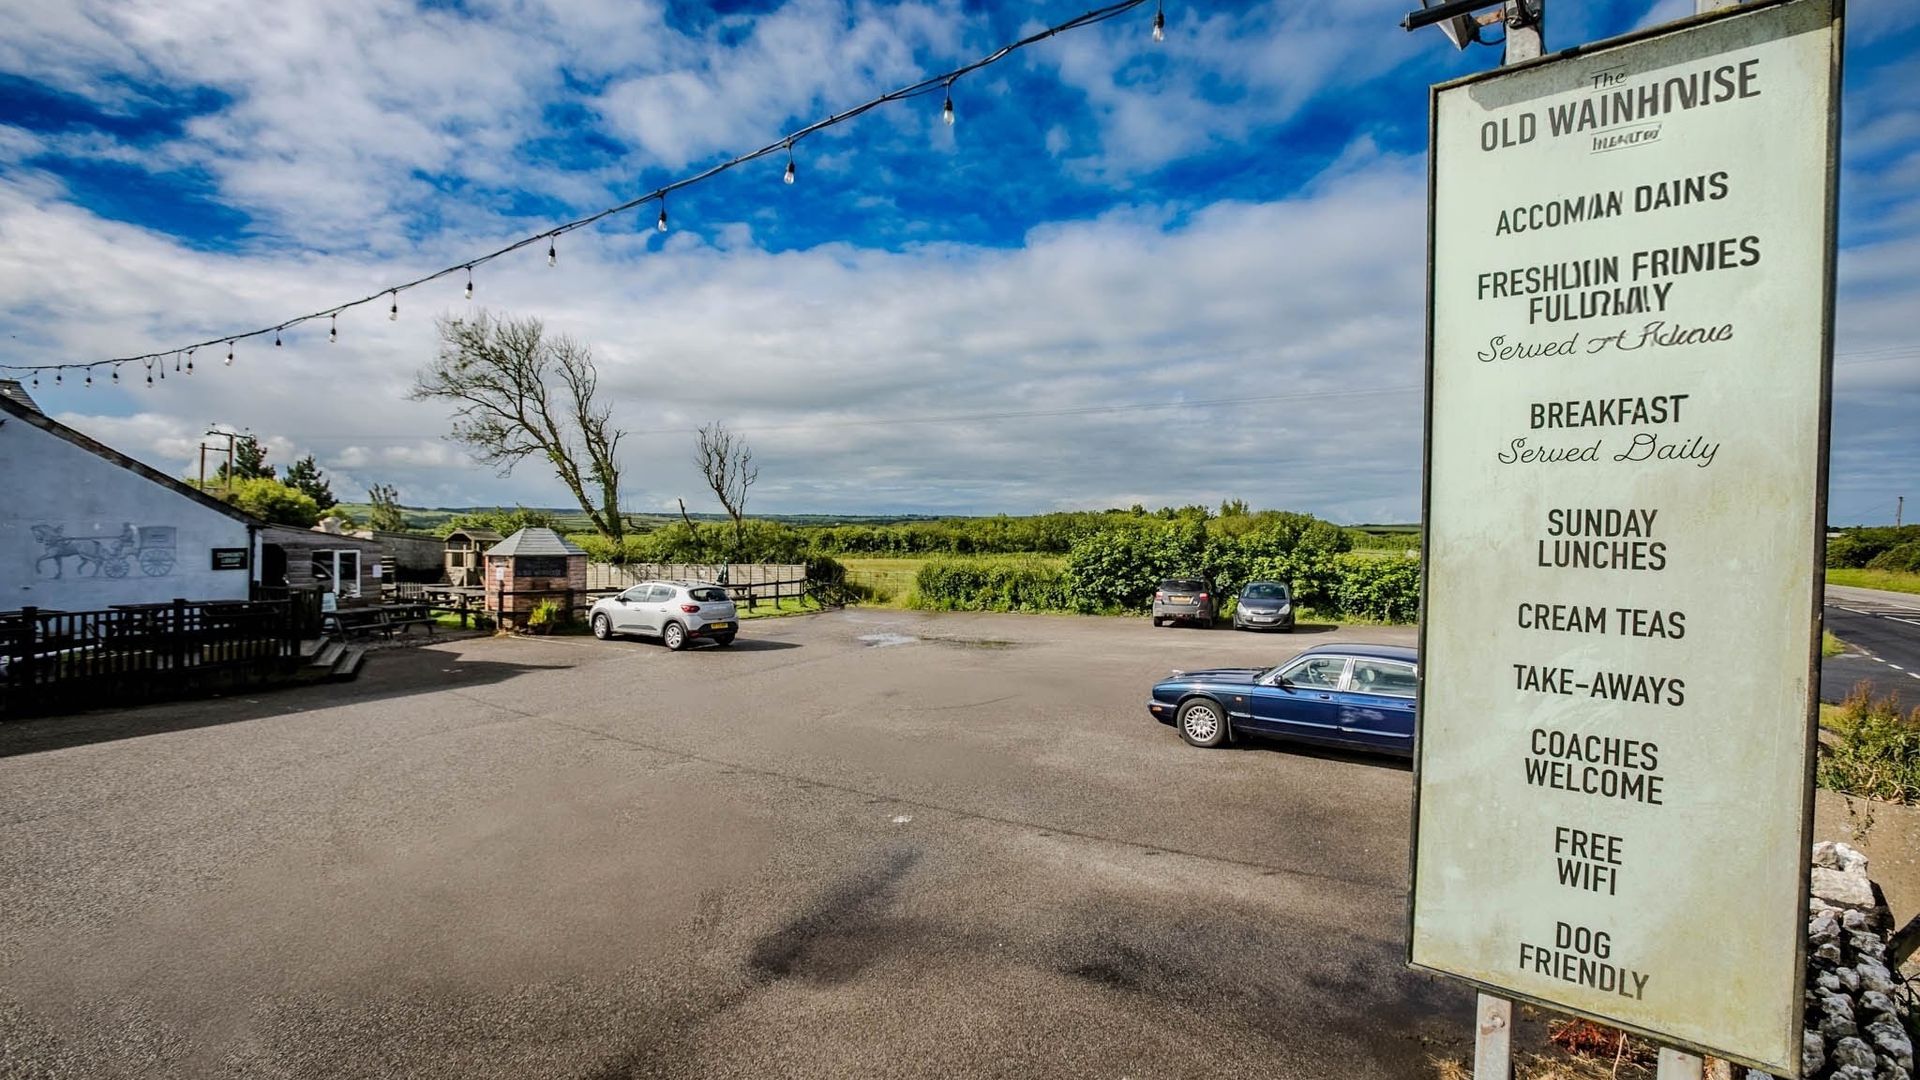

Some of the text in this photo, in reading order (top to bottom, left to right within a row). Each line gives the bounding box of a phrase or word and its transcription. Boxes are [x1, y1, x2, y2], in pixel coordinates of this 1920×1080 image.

[1591, 71, 1628, 90] The
[1481, 112, 1537, 152] OLD
[1477, 332, 1580, 363] Served
[1530, 394, 1689, 430] BREAKFAST
[1498, 433, 1721, 468] Served Daily
[1547, 508, 1659, 538] SUNDAY
[1538, 539, 1667, 572] LUNCHES
[1518, 602, 1686, 640] CREAM TEAS
[1513, 663, 1686, 707] TAKE-AWAYS
[1531, 728, 1659, 772] COACHES
[1524, 757, 1664, 806] WELCOME
[1554, 825, 1624, 866] FREE
[1556, 857, 1617, 896] WIFI
[1555, 920, 1612, 960] DOG
[1519, 942, 1650, 1002] FRIENDLY
